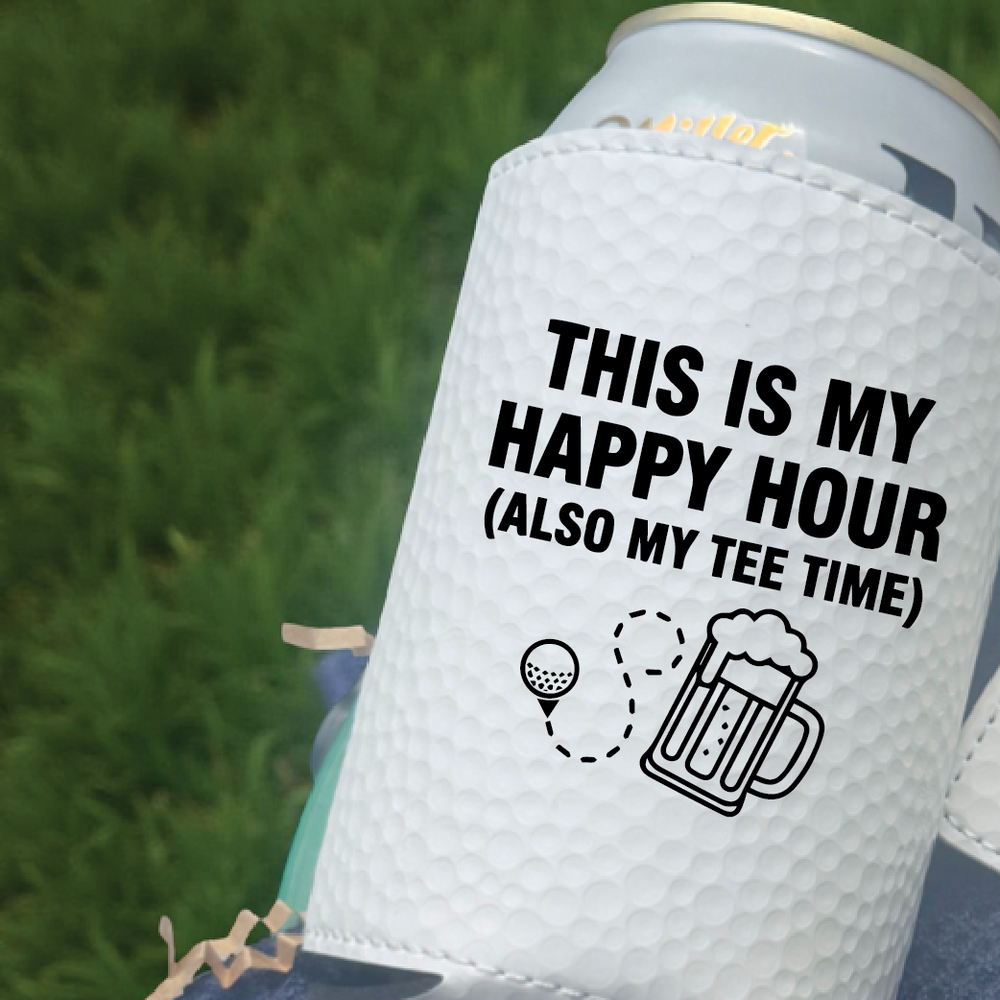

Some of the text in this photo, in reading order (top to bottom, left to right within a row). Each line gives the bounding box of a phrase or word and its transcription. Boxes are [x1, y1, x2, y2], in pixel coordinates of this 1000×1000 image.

[548, 319, 937, 465] THIS IS MY
[488, 400, 948, 562] HAPPY HOUR
[484, 487, 924, 630] (ALSO MY TEE TIME)
